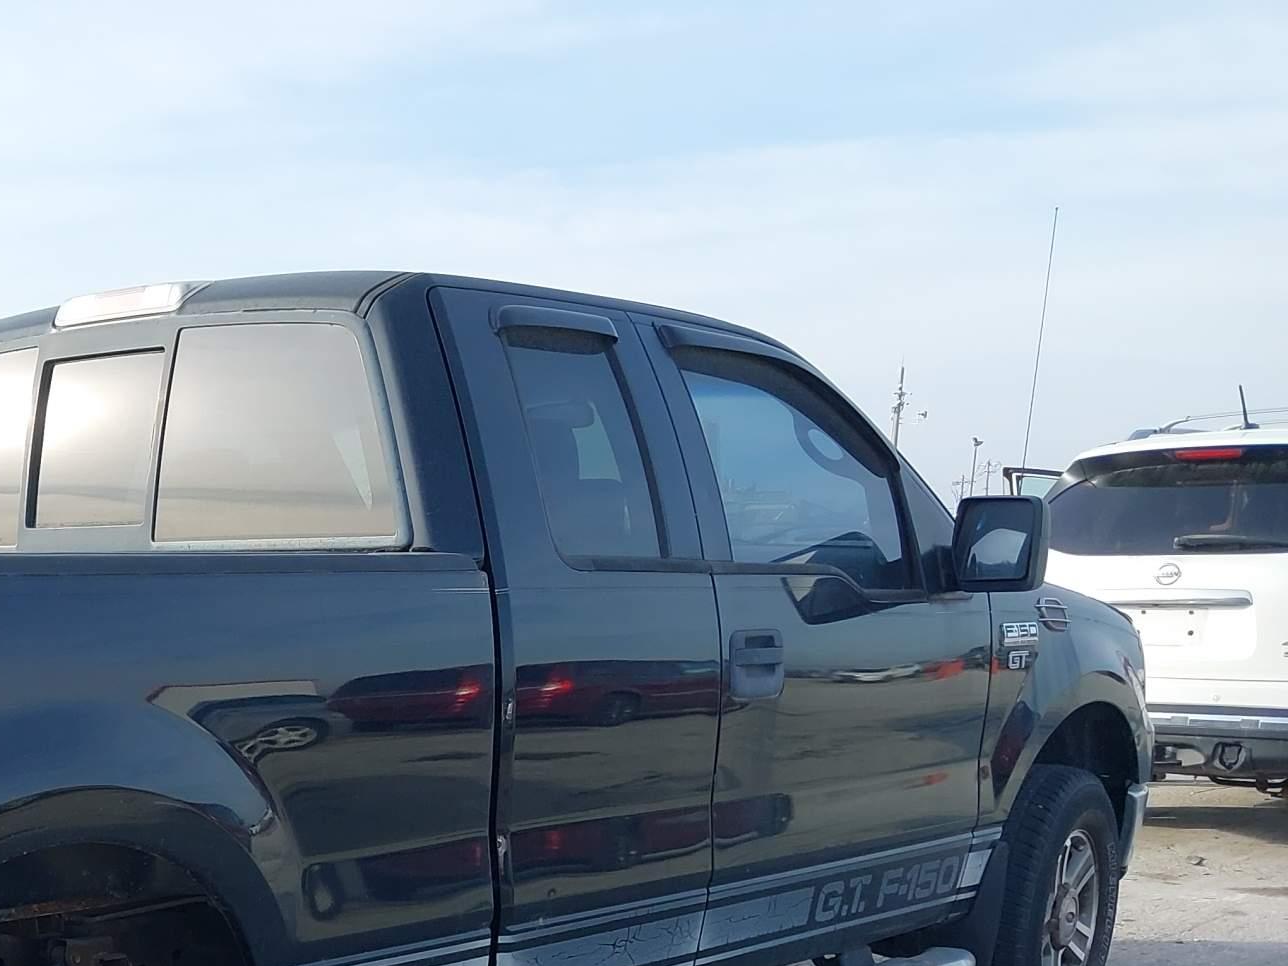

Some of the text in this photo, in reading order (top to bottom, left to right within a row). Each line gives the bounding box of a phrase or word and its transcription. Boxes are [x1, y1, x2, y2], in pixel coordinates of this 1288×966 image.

[1008, 650, 1029, 669] GT
[815, 855, 960, 922] G.T. F-150
